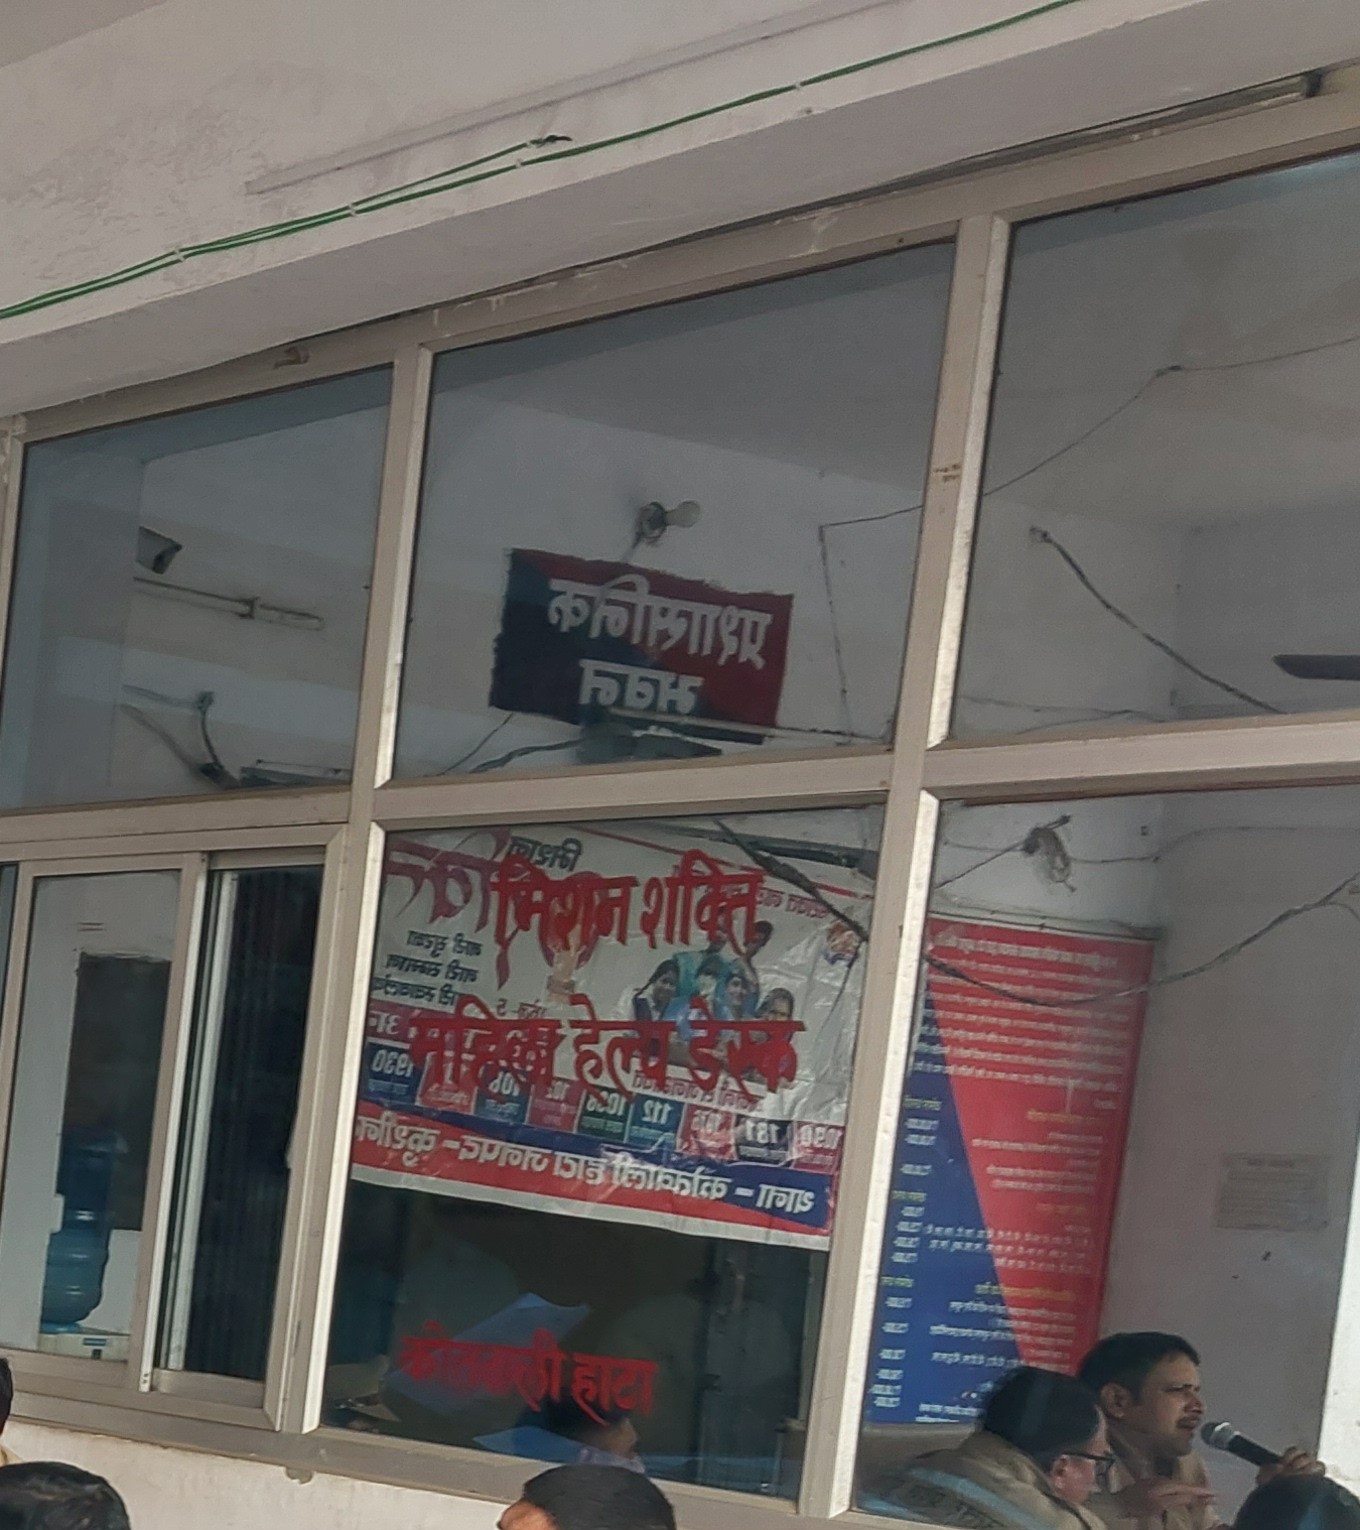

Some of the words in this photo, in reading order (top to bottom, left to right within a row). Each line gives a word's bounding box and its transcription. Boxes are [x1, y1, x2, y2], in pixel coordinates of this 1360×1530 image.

[489, 854, 640, 950] मिशन
[639, 848, 769, 957] शक्ति
[572, 1351, 659, 1426] हाटा
